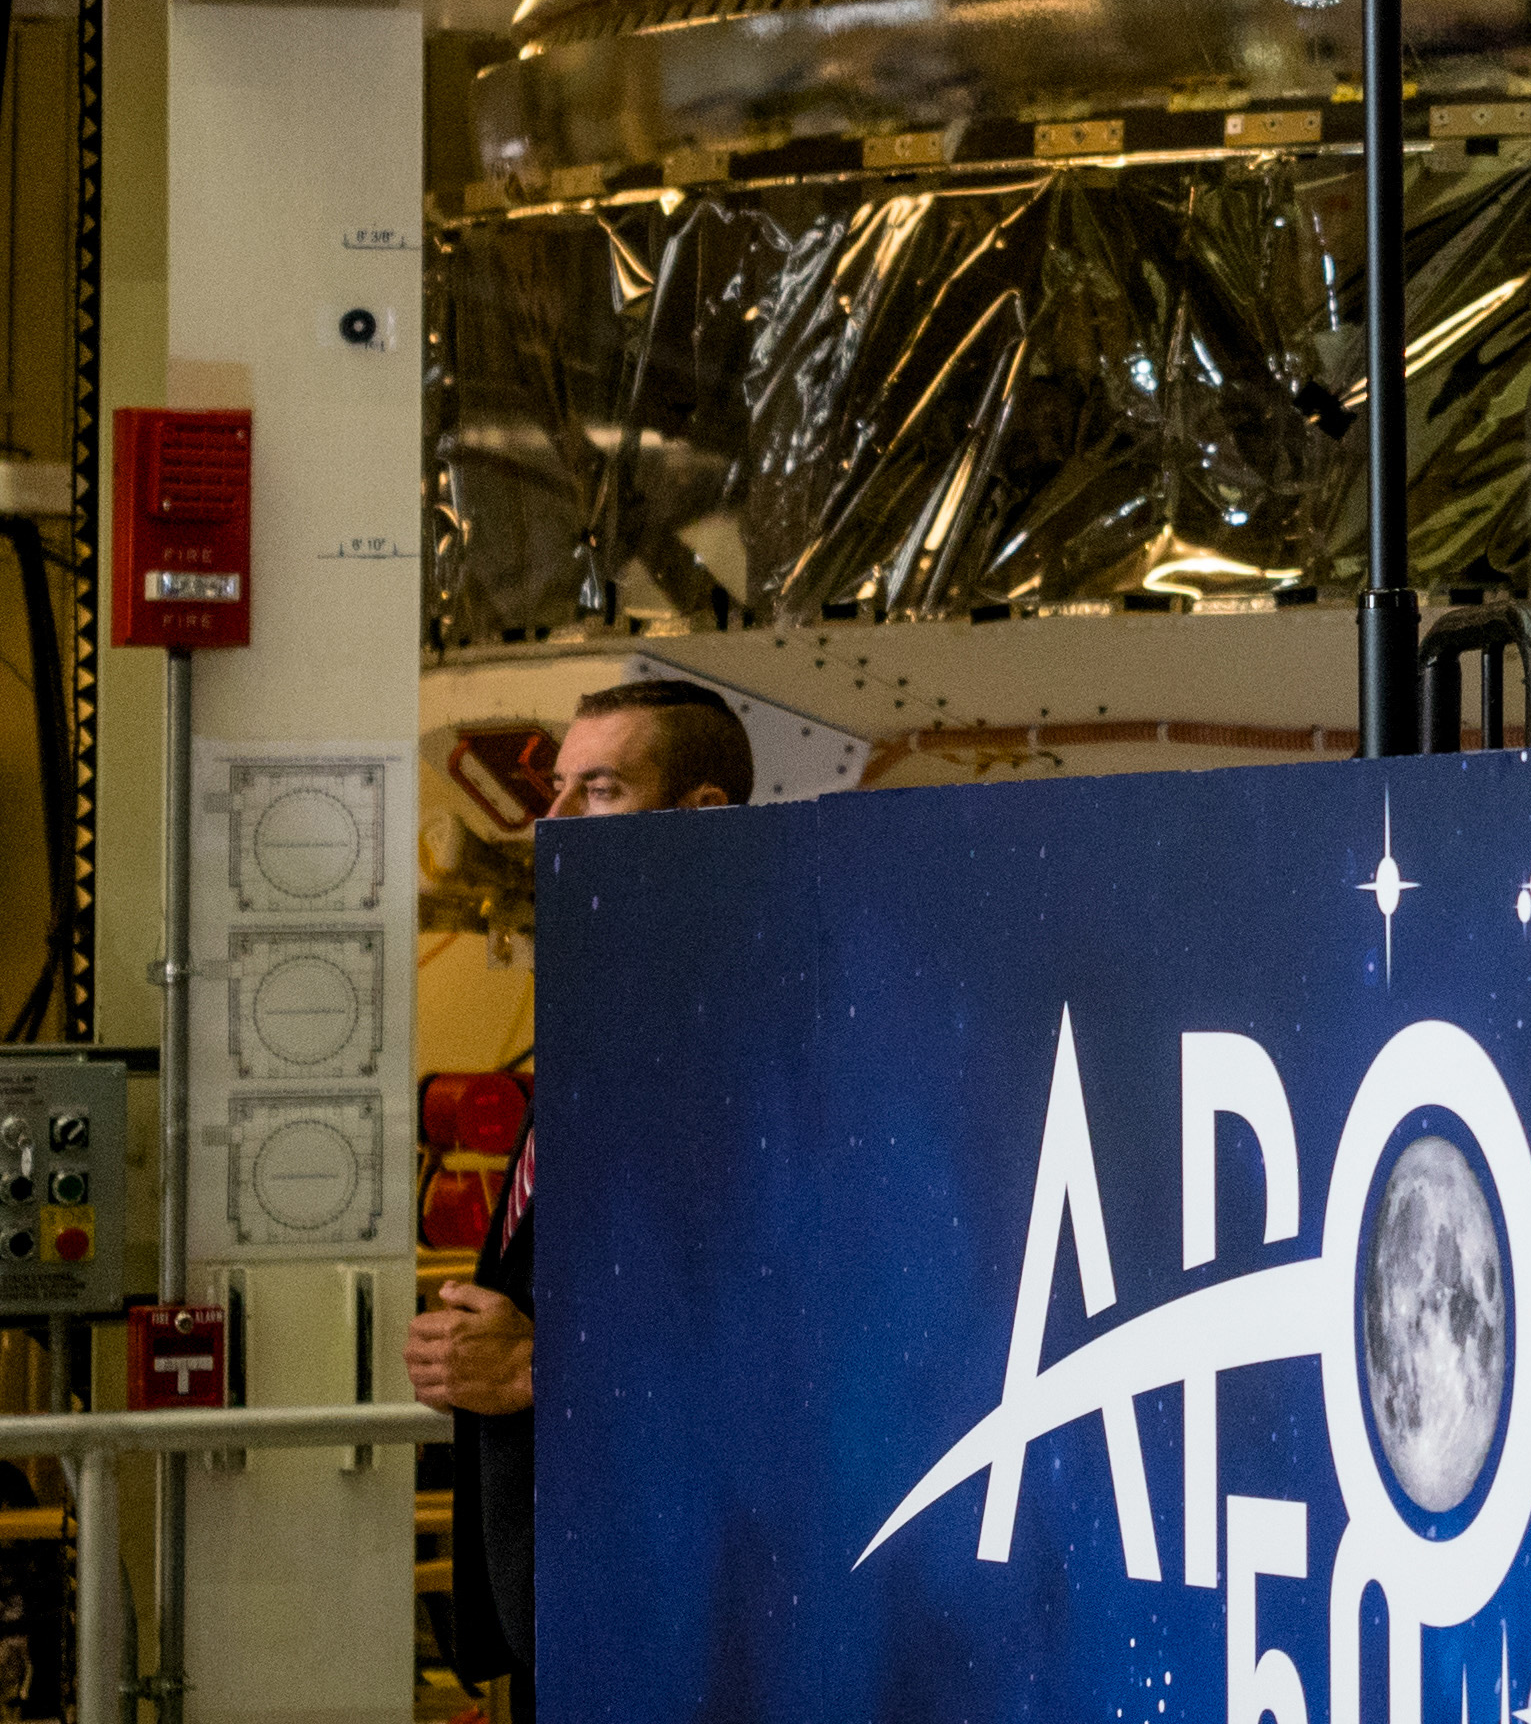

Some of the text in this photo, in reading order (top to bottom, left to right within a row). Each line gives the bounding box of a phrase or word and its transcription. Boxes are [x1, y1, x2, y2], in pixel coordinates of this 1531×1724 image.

[163, 547, 213, 564] FIRE
[162, 613, 213, 629] FIRE
[151, 1310, 224, 1326] FIRE ALARM
